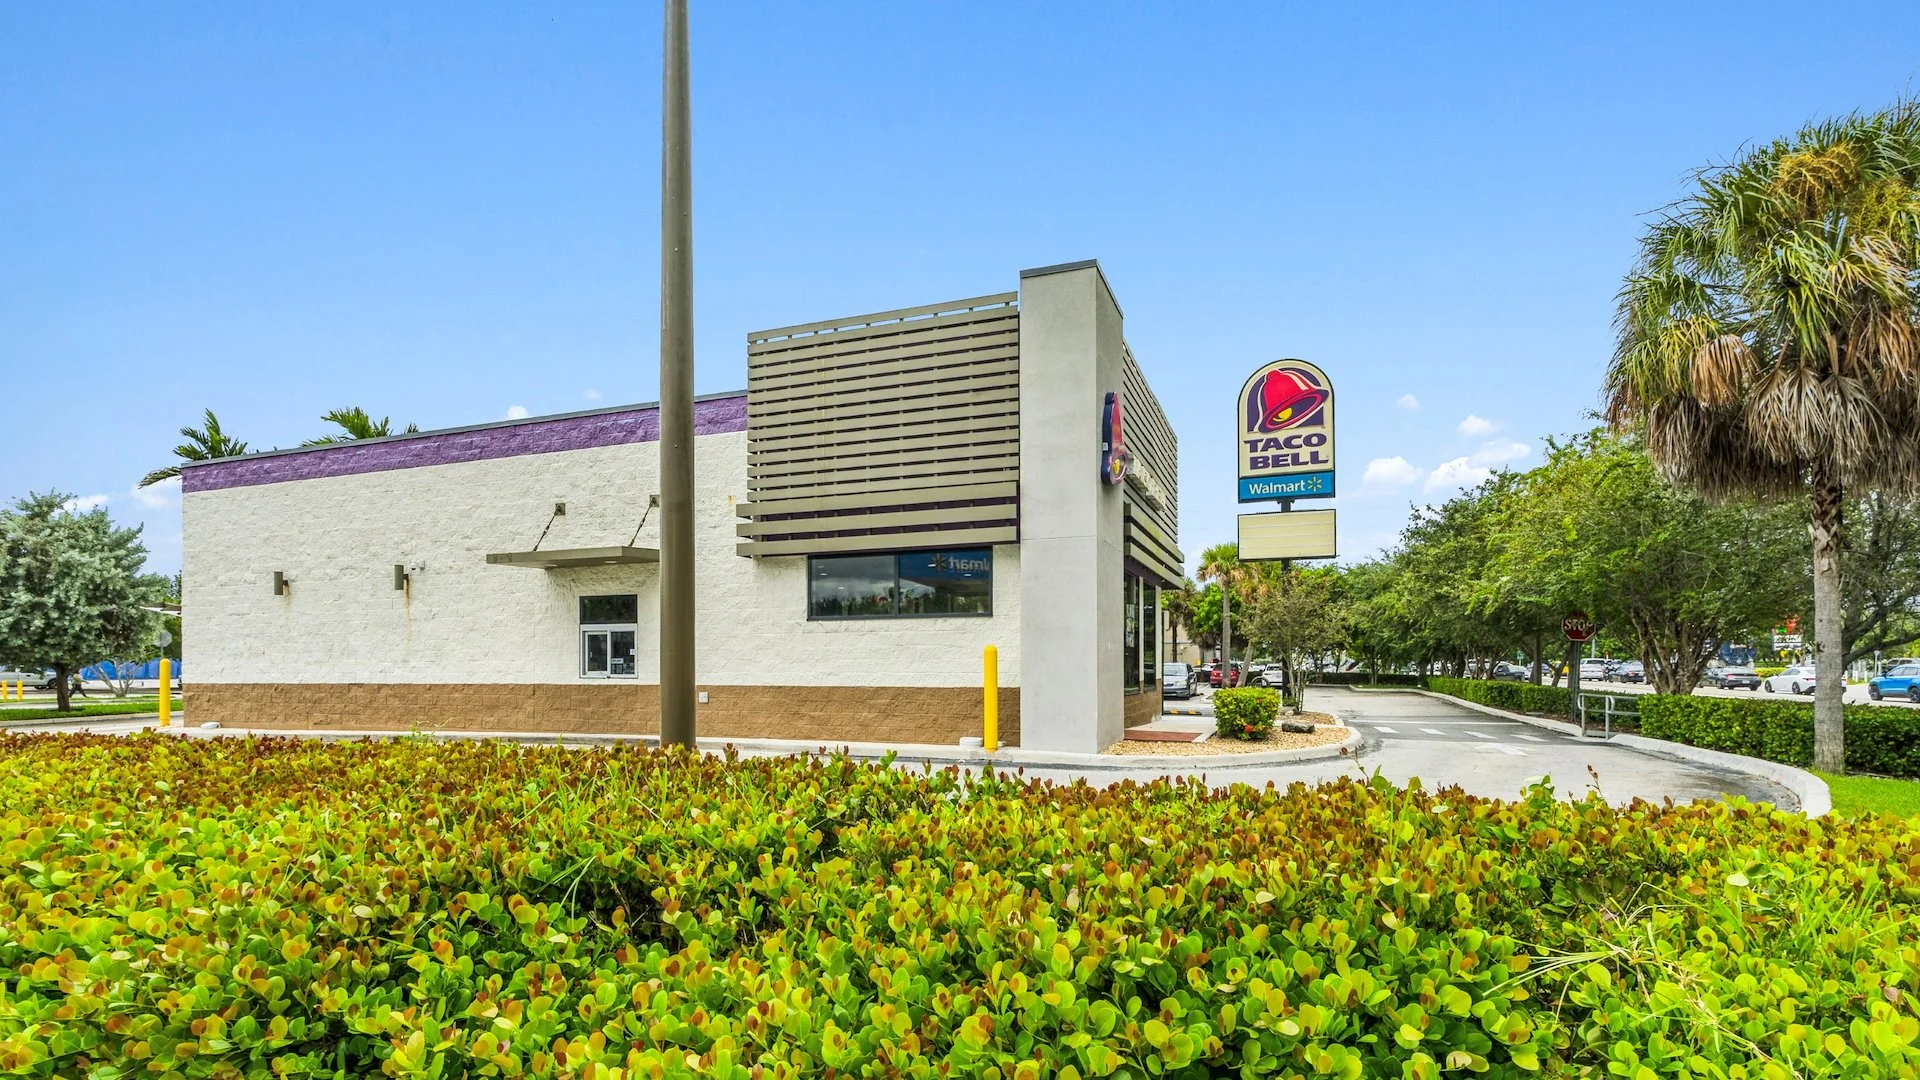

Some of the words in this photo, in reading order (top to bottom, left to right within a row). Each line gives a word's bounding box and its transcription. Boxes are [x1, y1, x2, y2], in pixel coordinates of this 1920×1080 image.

[1243, 433, 1327, 453] TACO
[1249, 451, 1329, 470] BELL
[1249, 480, 1306, 495] Walmart
